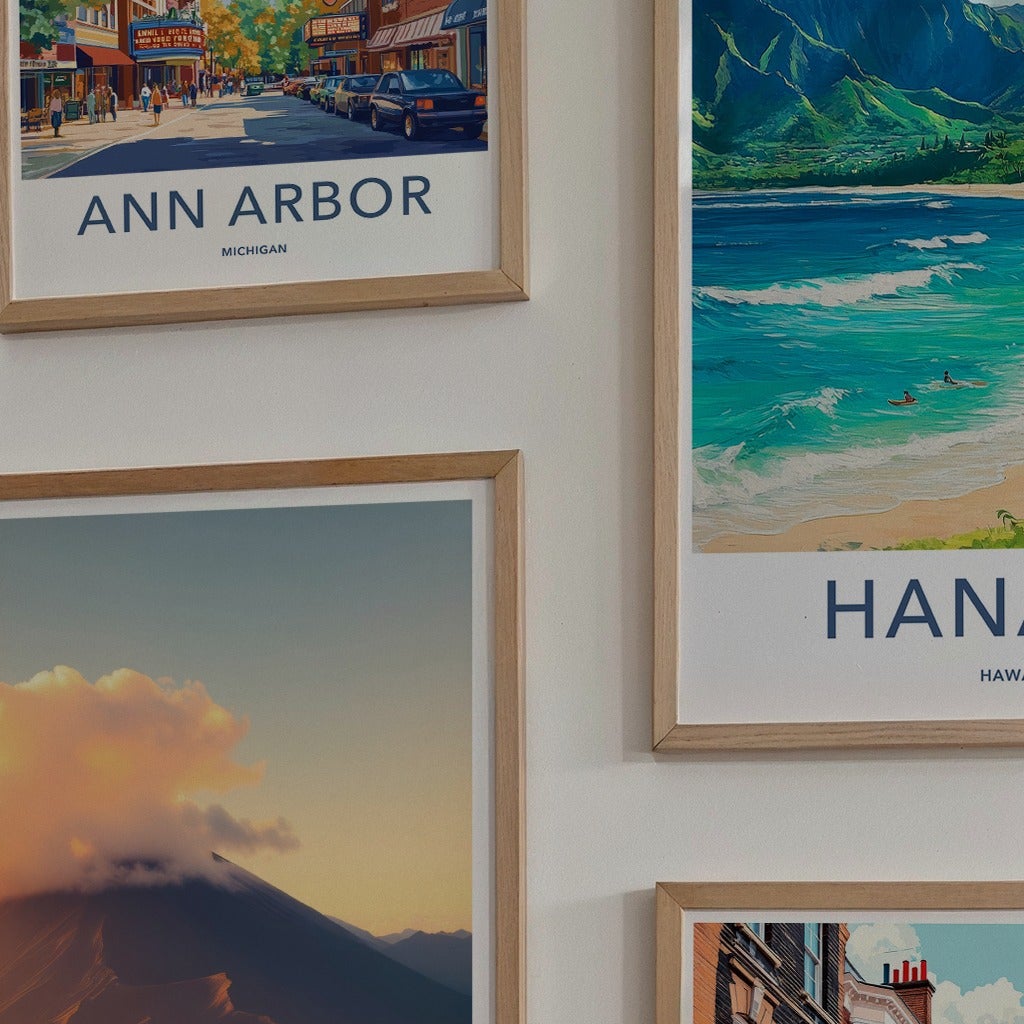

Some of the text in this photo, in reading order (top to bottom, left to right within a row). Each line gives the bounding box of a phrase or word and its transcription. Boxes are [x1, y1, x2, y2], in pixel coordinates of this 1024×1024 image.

[77, 175, 432, 236] ANN ARBOR
[221, 244, 287, 257] MICHIGAN
[827, 577, 1024, 639] HAN
[980, 668, 1024, 682] HAW
